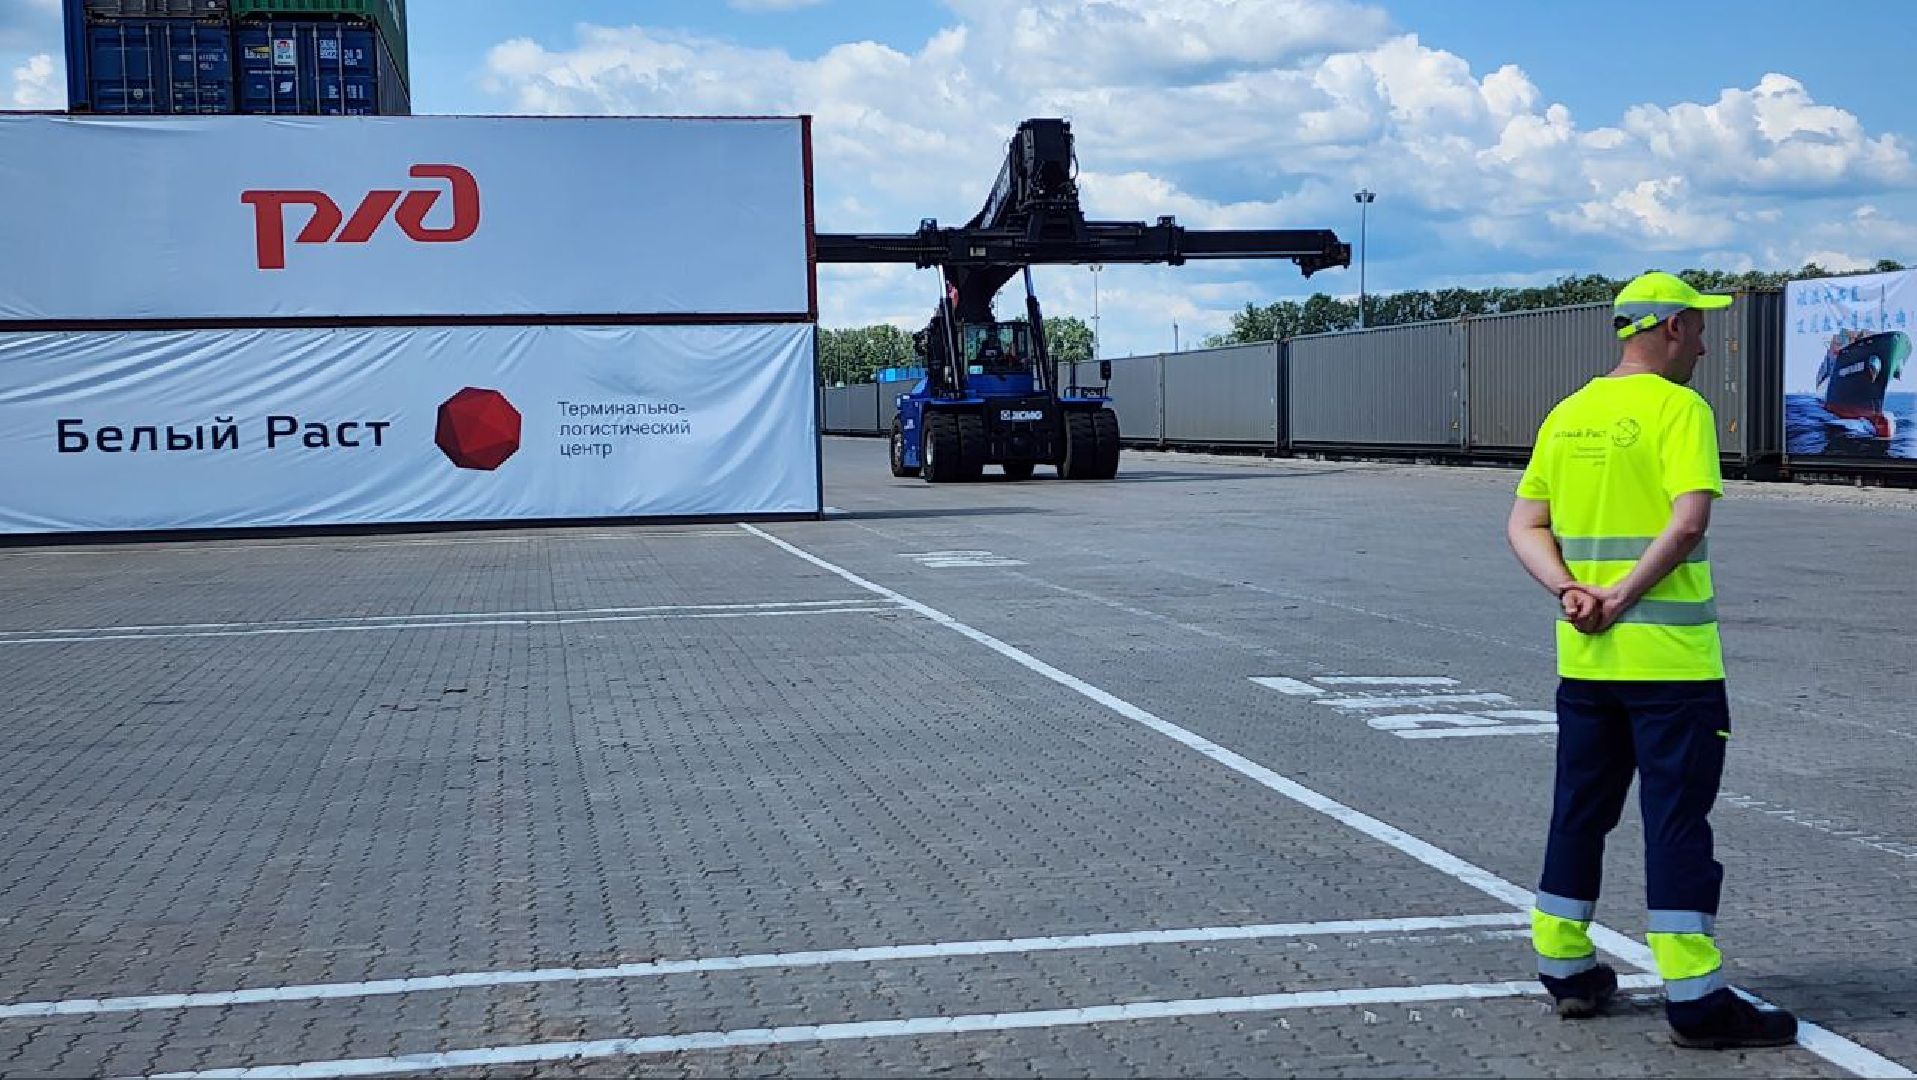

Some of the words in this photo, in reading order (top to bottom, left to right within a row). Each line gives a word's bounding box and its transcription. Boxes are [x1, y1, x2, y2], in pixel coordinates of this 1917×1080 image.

[557, 401, 686, 419] Терминально-
[57, 414, 239, 453] Белый
[266, 415, 391, 449] Раст
[559, 419, 691, 436] логистический
[560, 442, 613, 459] центр
